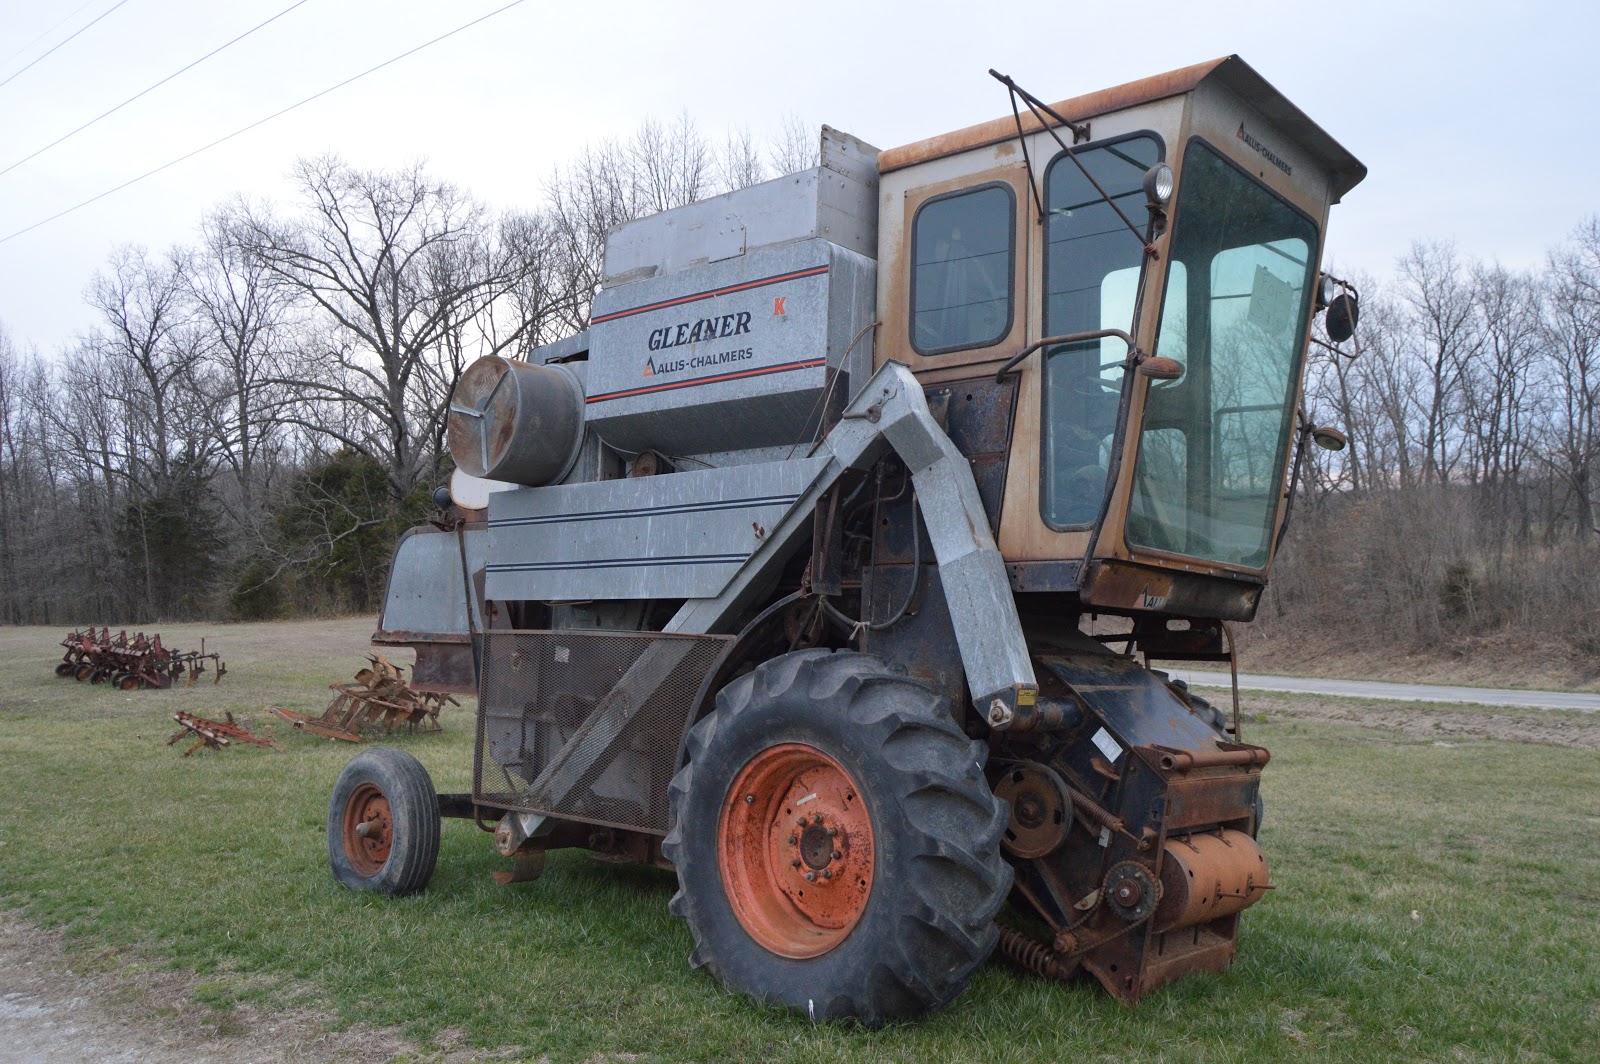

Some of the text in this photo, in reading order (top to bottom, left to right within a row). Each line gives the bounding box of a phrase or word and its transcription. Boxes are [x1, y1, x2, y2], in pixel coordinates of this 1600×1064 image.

[1244, 132, 1292, 176] ALLIS-CHALMERS
[773, 296, 787, 316] K
[648, 311, 752, 352] GLEANER
[656, 347, 753, 375] ALLIS-CHALMERS
